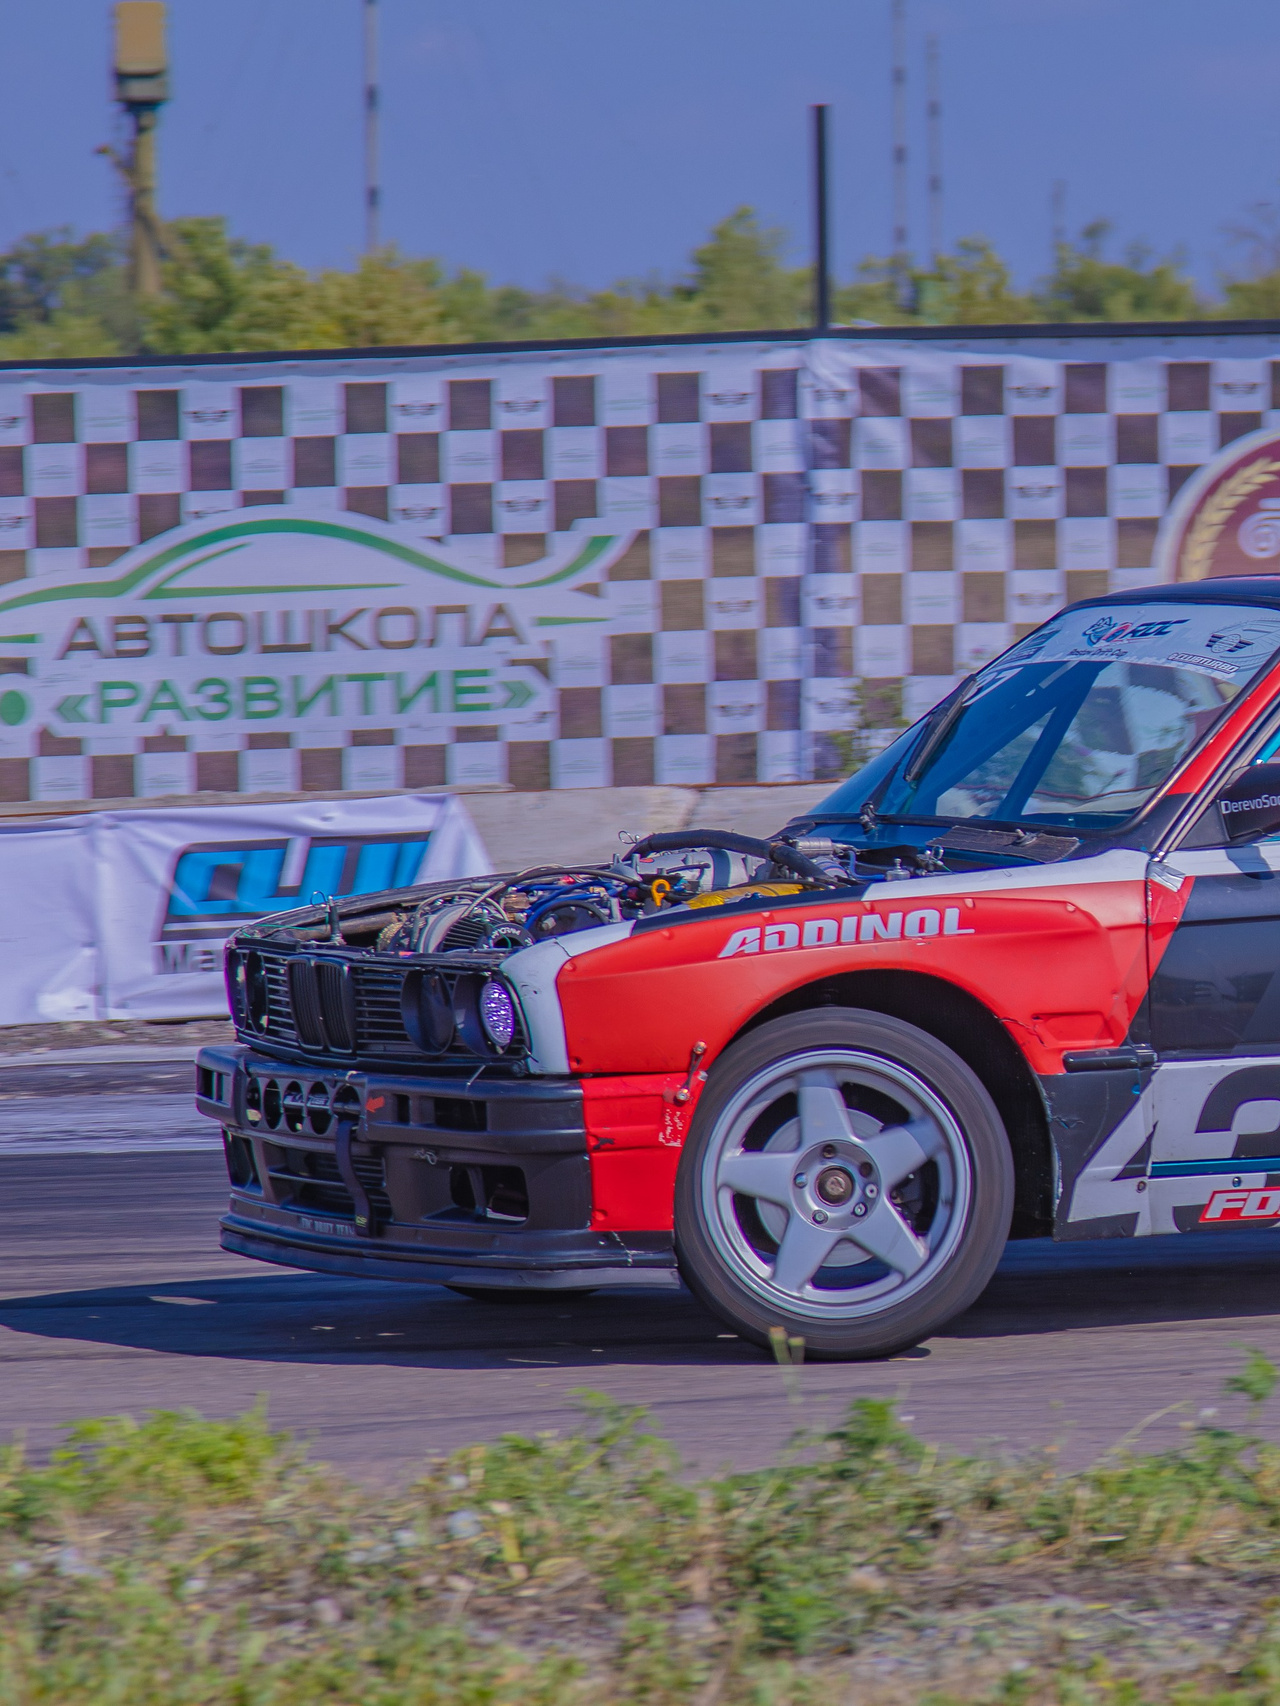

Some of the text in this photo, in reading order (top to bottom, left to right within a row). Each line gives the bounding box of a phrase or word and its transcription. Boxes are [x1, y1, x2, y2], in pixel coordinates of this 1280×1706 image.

[55, 602, 526, 661] АВТОШКОЛА
[51, 667, 537, 725] «РАЗВИТИЕ»
[717, 907, 975, 959] ADDINOL
